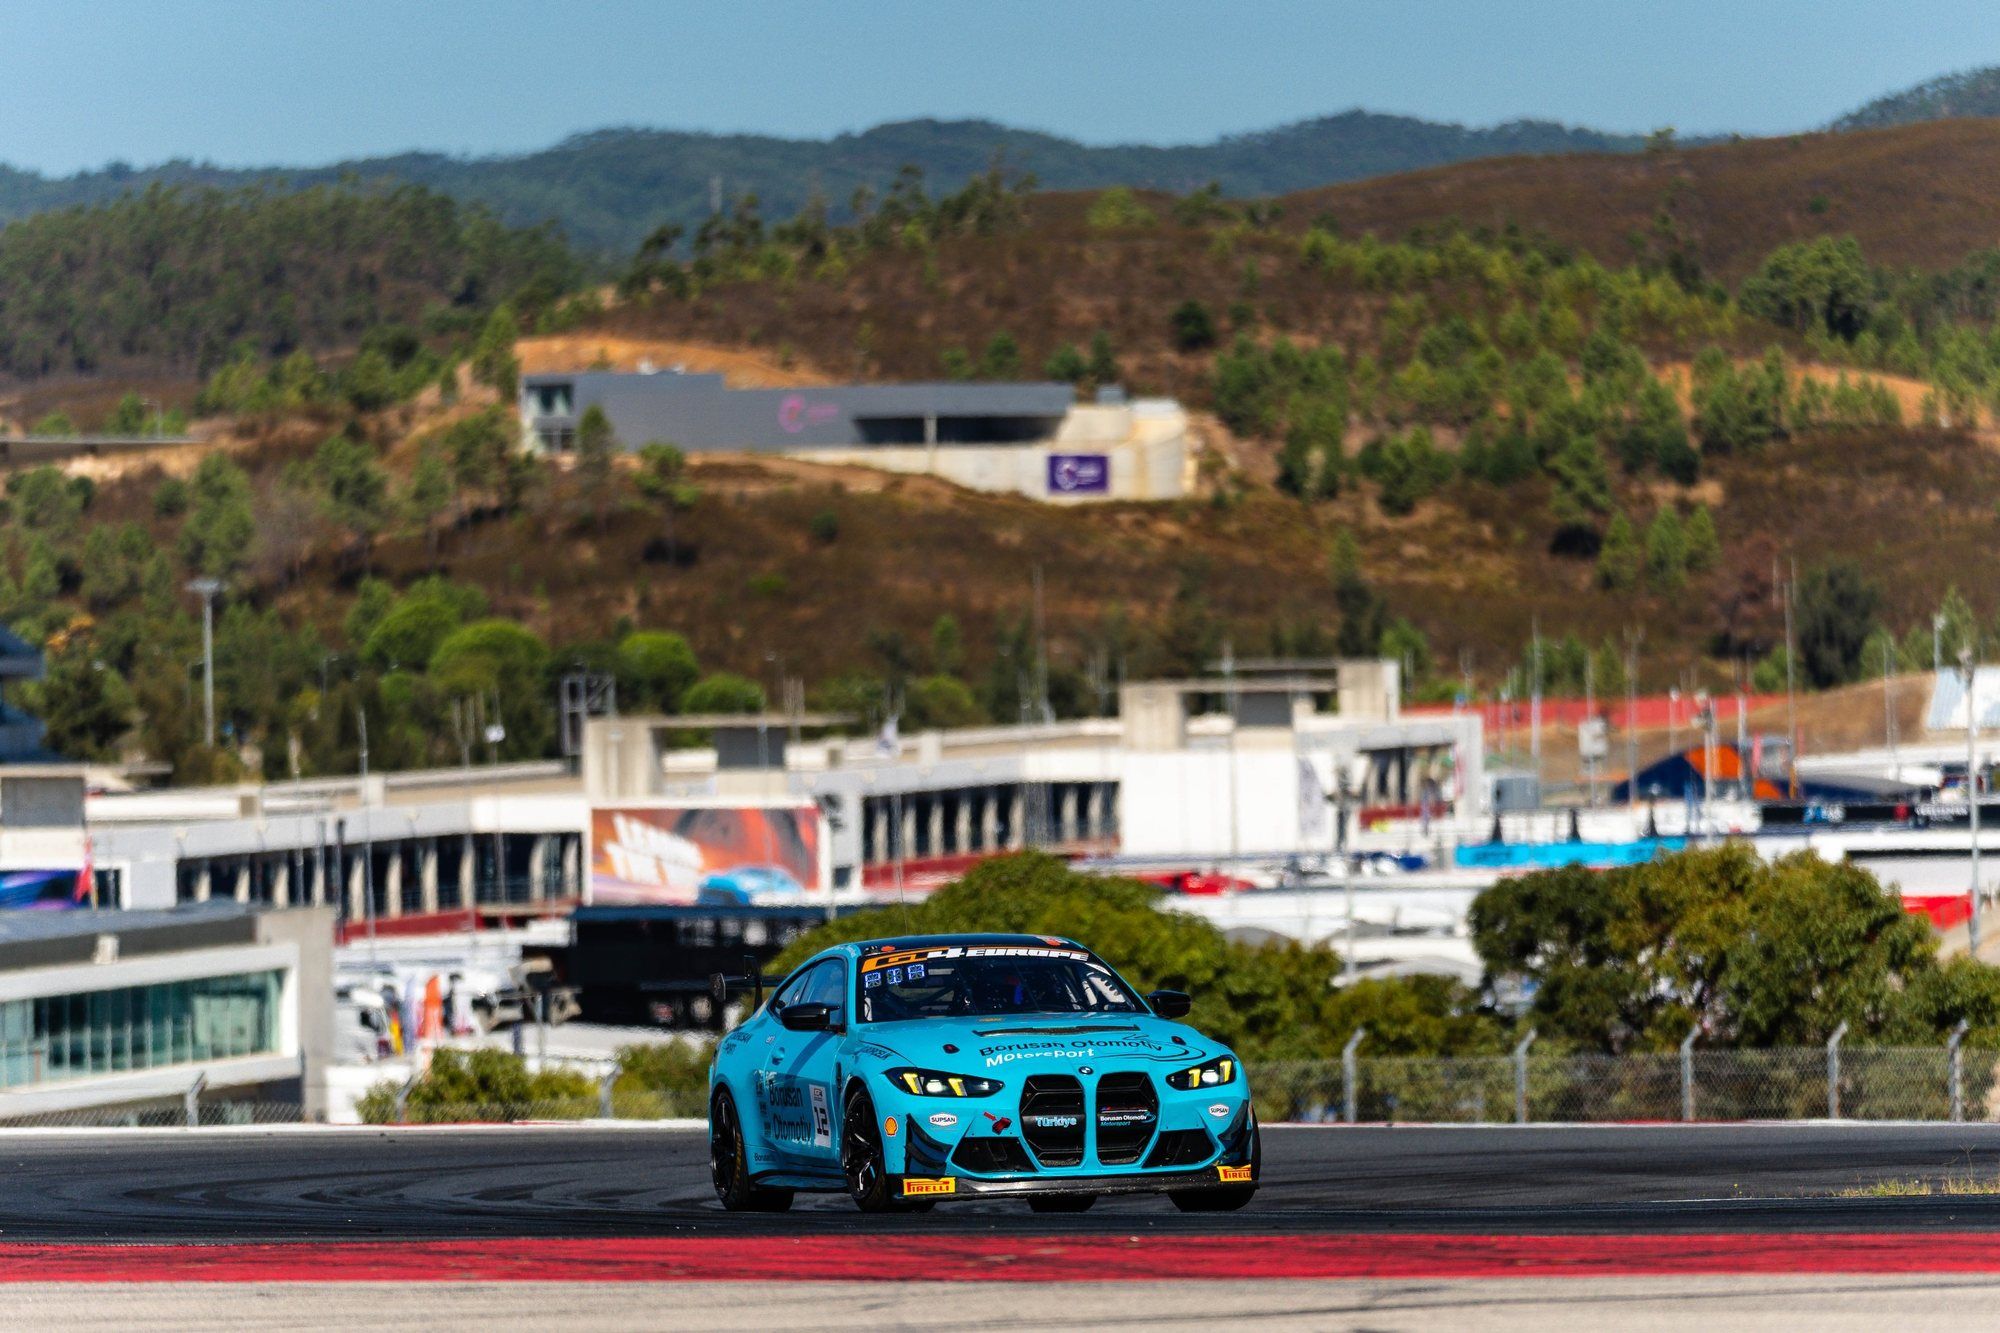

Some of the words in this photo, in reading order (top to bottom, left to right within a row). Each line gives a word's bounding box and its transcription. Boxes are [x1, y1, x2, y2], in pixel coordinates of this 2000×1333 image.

[966, 948, 1089, 961] EUROPE
[980, 1041, 1064, 1056] Borusan
[1071, 1039, 1162, 1051] Otomotiv
[986, 1048, 1094, 1068] Motorsport
[1035, 1116, 1077, 1128] Türkiye
[907, 1181, 950, 1193] PIRELLI
